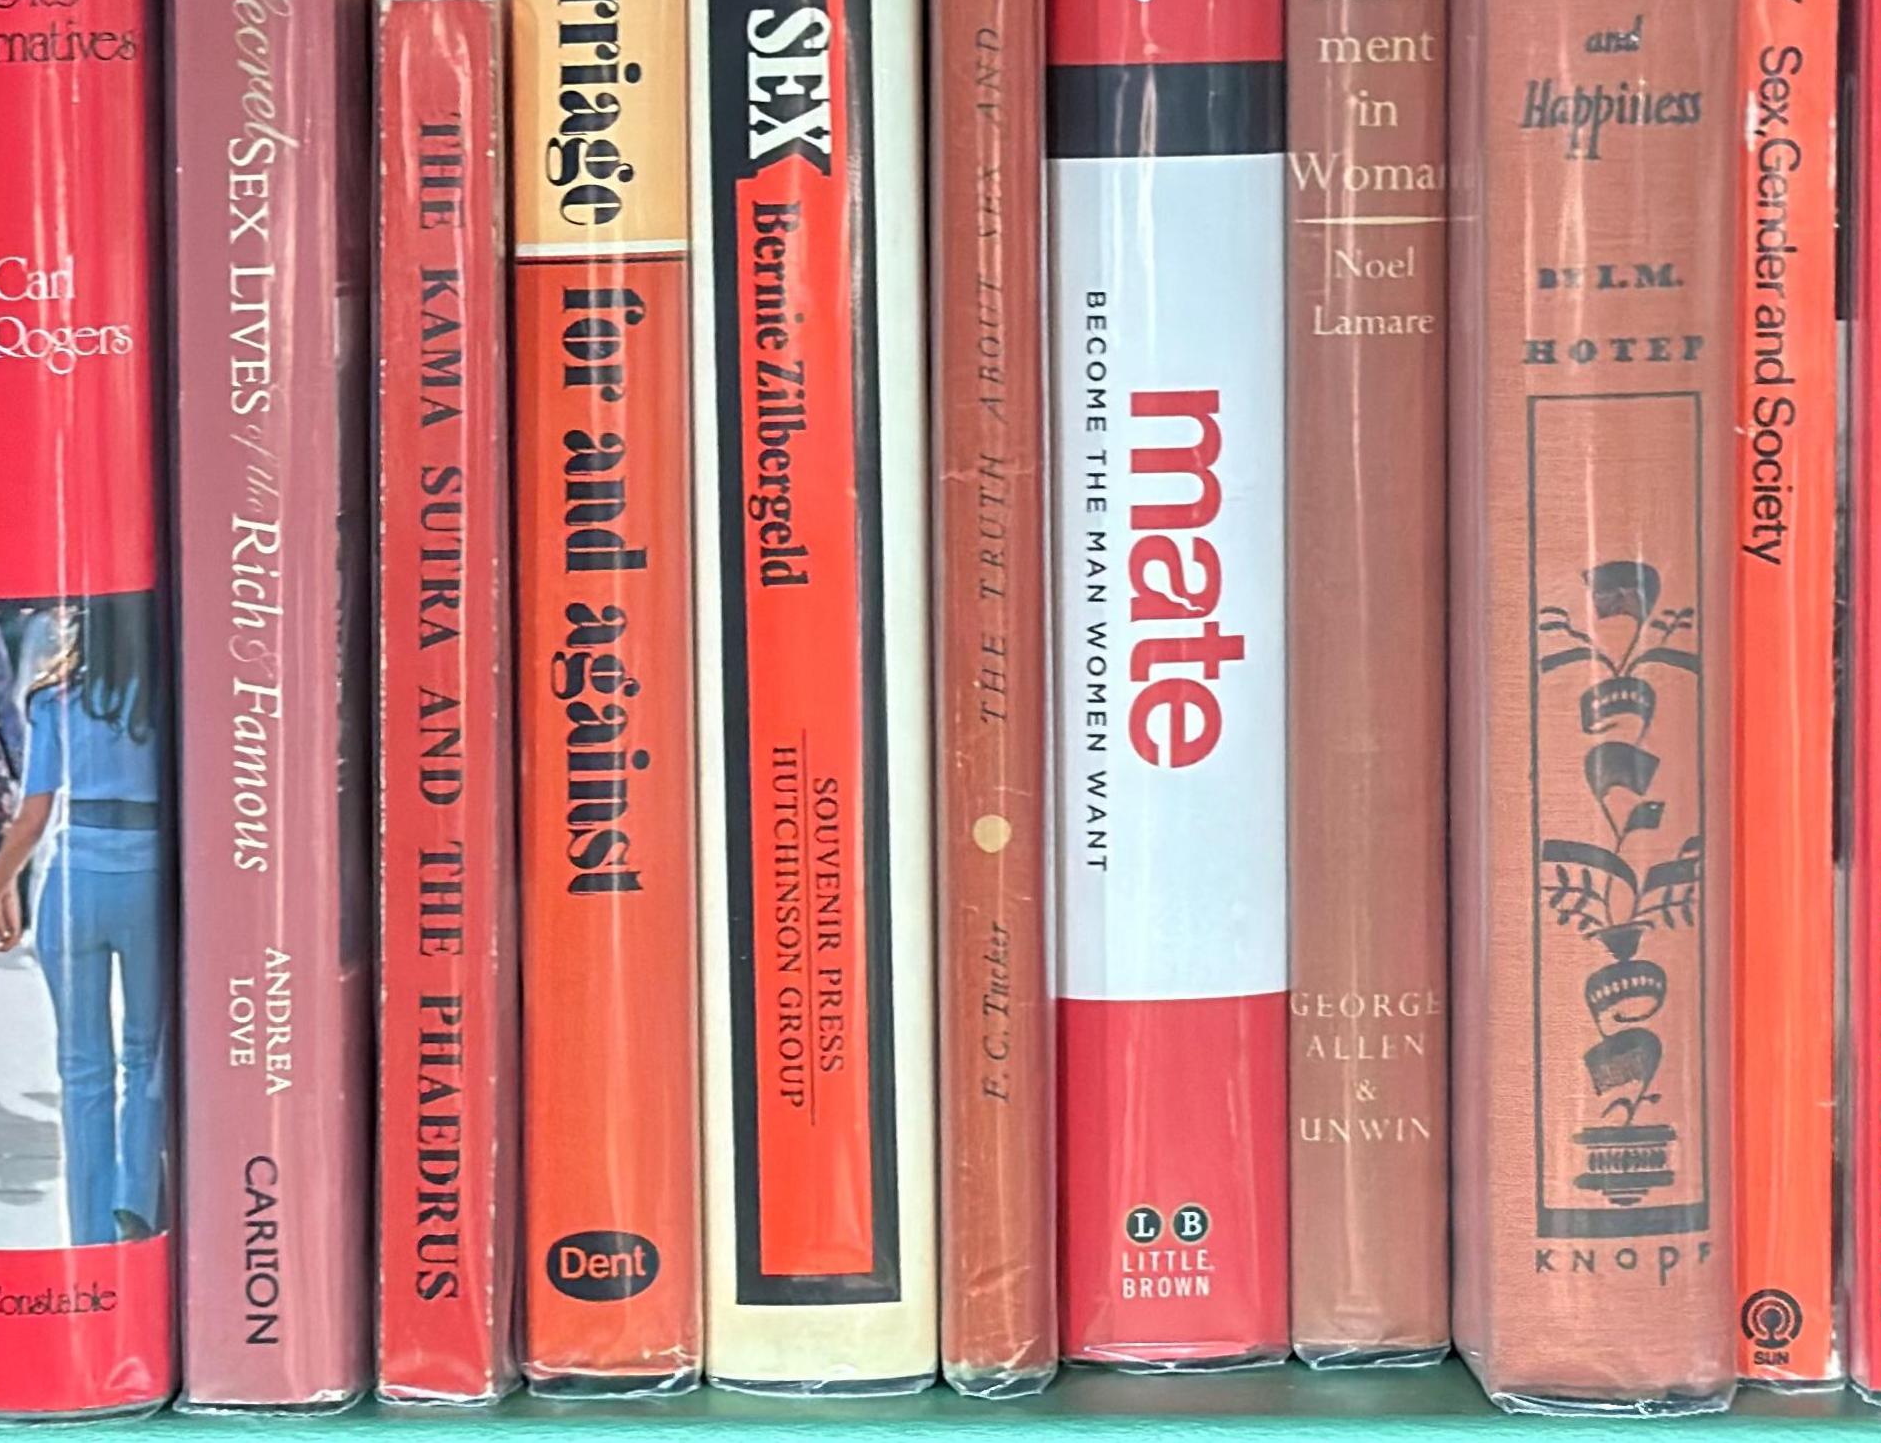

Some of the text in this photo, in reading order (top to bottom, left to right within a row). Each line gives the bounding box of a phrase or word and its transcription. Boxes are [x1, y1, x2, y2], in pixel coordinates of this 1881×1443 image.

[747, 9, 831, 161] SEX
[1319, 27, 1434, 64] ment
[1357, 96, 1398, 128] in
[1521, 80, 1702, 161] Happiness
[1314, 305, 1434, 336] Lamare
[1336, 248, 1415, 279] Noel
[562, 285, 647, 403] for
[748, 200, 810, 587] Bernie Zilbergeld
[227, 138, 284, 874] SEX LIVES Rich Famous
[563, 429, 647, 574] and
[1743, 303, 1799, 566] and Society
[978, 455, 1009, 724] THE TRUTH
[1086, 291, 1108, 871] BECOME THE MAN WOMEN WANT
[1128, 389, 1245, 769] mate
[416, 266, 465, 1302] KAMA SUTRA AND THE PHAEDRUS
[551, 602, 650, 895] against
[771, 746, 805, 1108] HUTCHINSON GROUP
[814, 778, 844, 1072] SOUVENIR PRESS
[230, 976, 254, 1068] LOVE
[265, 946, 292, 1097] ANDREA
[1308, 1033, 1426, 1059] ALLEN
[1300, 1117, 1431, 1143] UNWIN
[244, 1156, 280, 1345] CARLTON
[560, 1247, 647, 1278] Dent
[1122, 1277, 1211, 1298] BROWN
[1754, 1351, 1790, 1365] SUN
